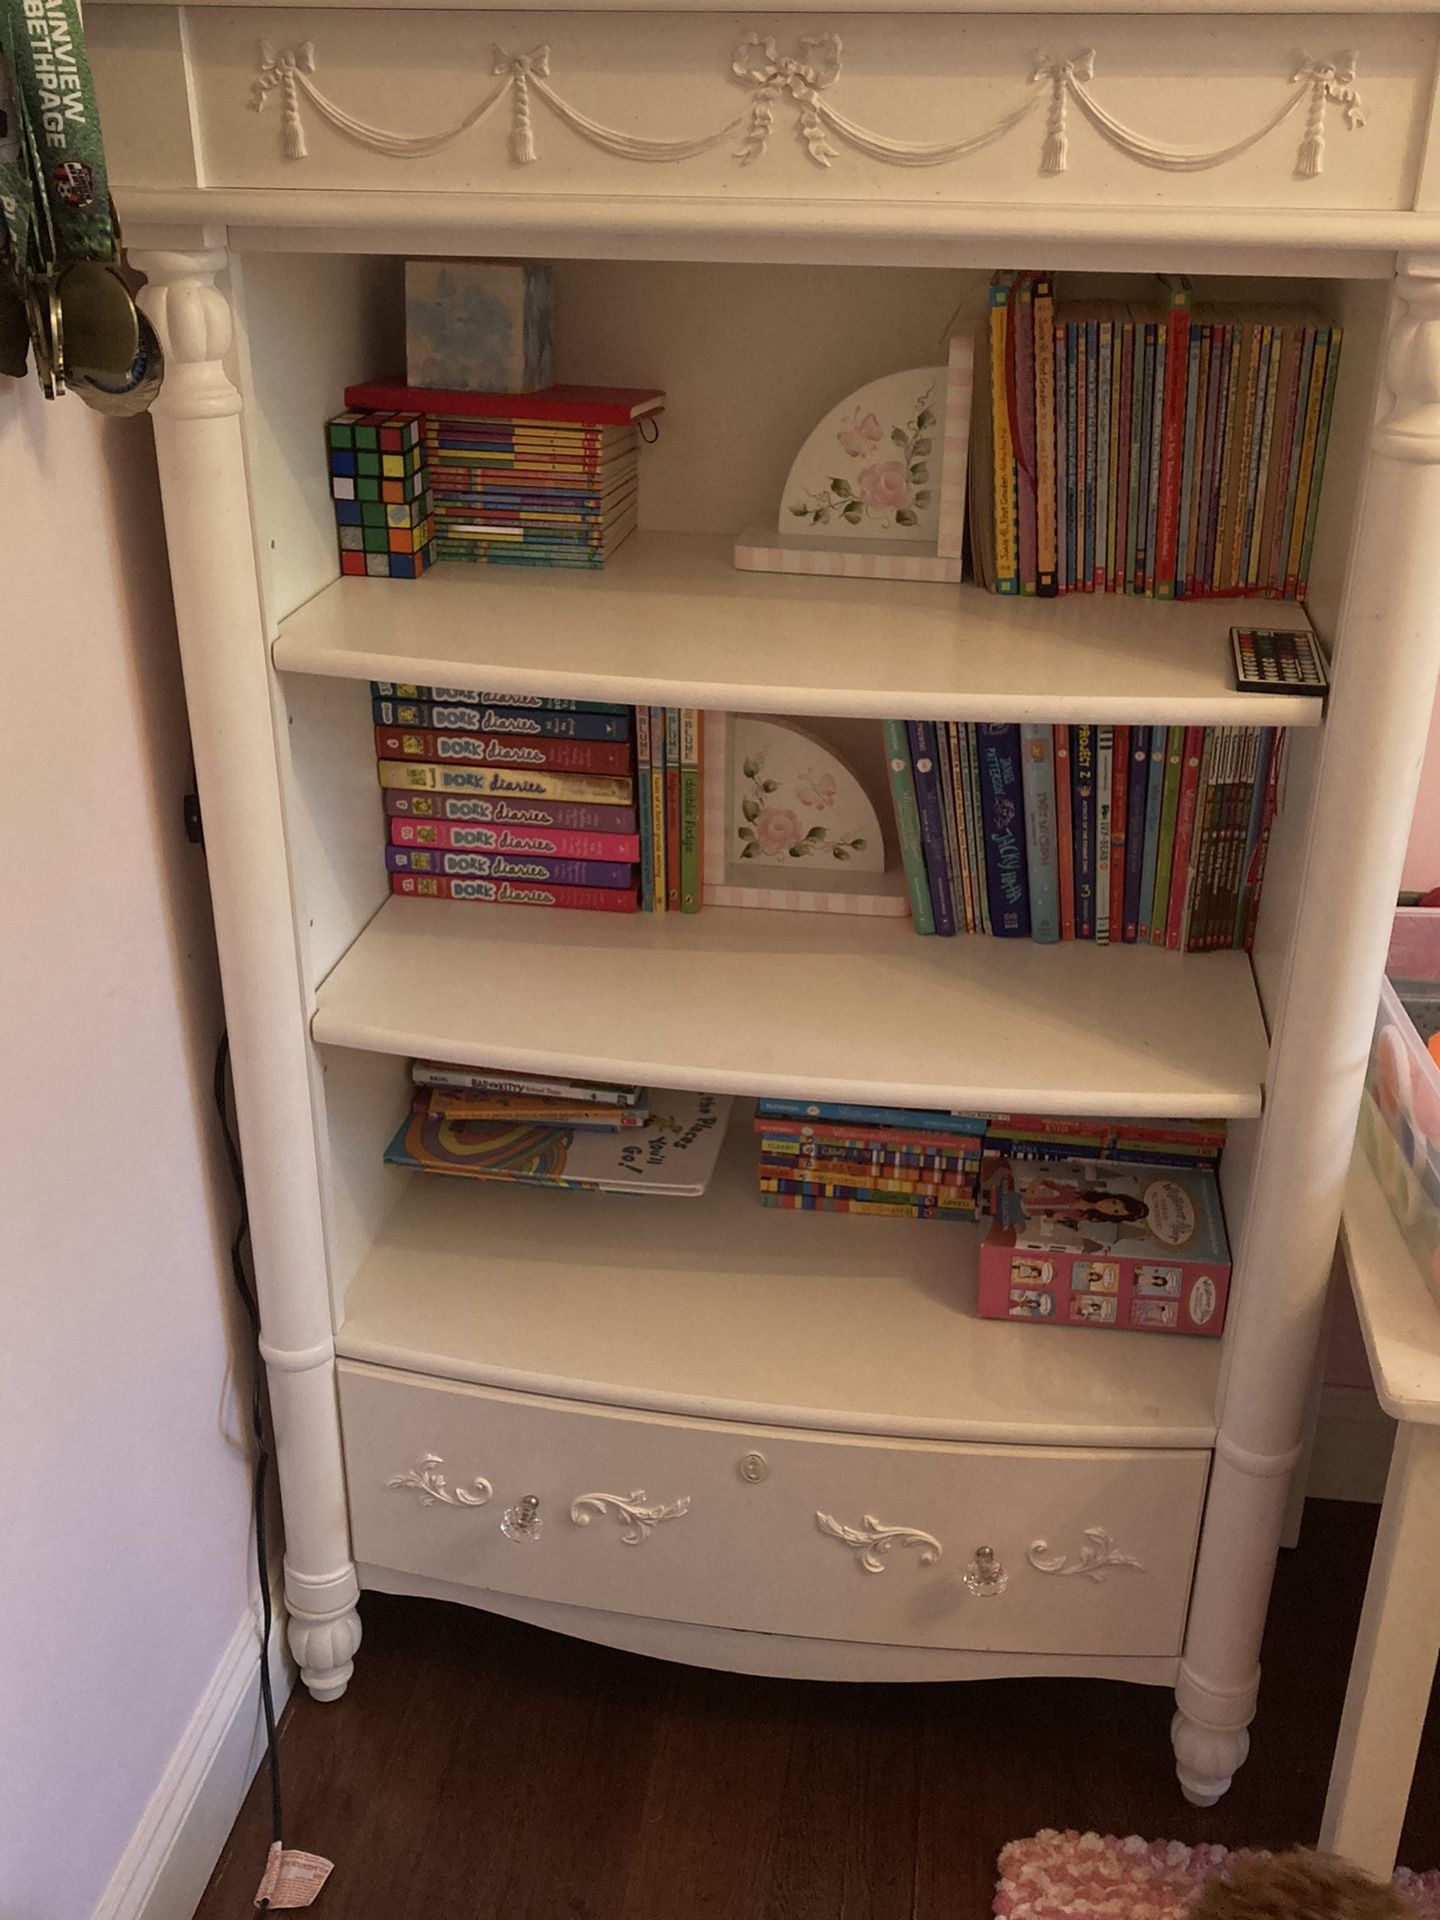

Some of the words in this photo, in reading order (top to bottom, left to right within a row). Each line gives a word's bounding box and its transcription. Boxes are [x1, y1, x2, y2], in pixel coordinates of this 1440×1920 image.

[23, 0, 66, 148] BETHPAGE
[435, 708, 479, 728] DORK
[483, 710, 540, 732] diaries
[440, 739, 483, 758] DORK
[487, 740, 544, 761] diaries
[1079, 723, 1092, 767] PROJECT
[443, 772, 484, 789] DORK
[490, 773, 545, 793] diaries
[986, 746, 1005, 796] PATTERSON
[1000, 756, 1014, 784] JAMES
[684, 777, 696, 815] double
[448, 801, 491, 819] DORK
[496, 802, 553, 824] diaries
[452, 829, 496, 847] DORK
[500, 831, 557, 852] diaries
[684, 819, 696, 852] fudge
[991, 826, 1020, 870] JACKY
[446, 855, 490, 874] DORK
[493, 857, 549, 878] diaries
[452, 882, 496, 900] DORK
[499, 884, 556, 905] diaries
[673, 1116, 717, 1152] Places
[618, 1145, 643, 1174] Go!
[646, 1136, 668, 1165] You'll
